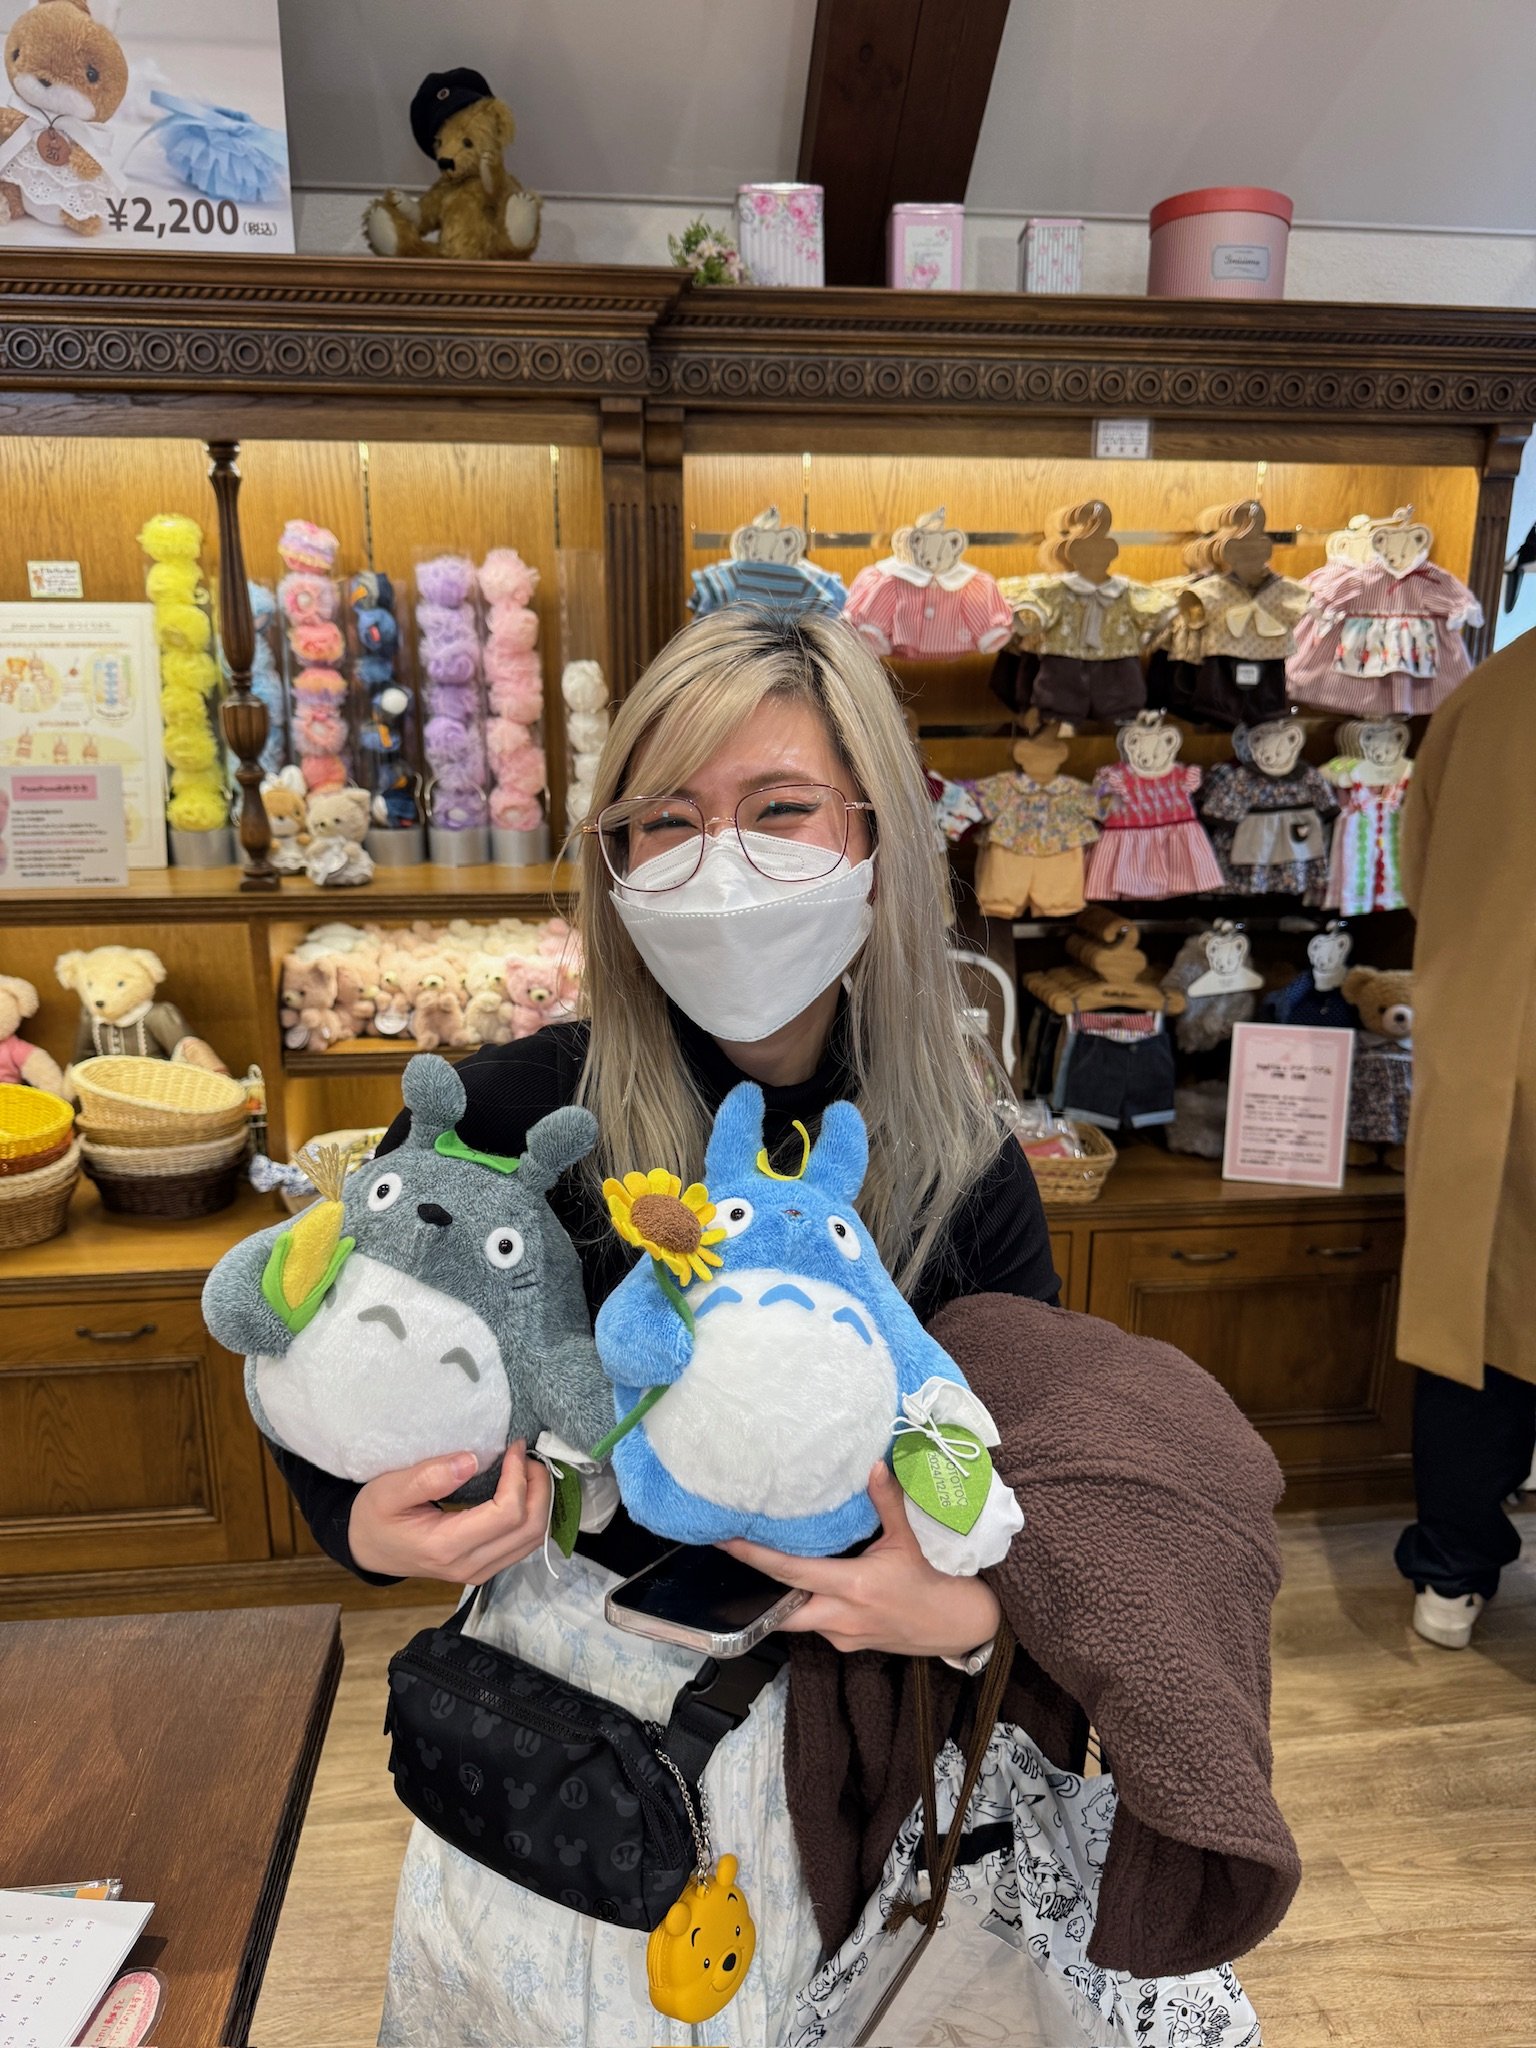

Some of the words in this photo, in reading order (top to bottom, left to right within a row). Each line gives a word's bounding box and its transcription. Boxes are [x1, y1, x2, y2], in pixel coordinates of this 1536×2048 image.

[105, 197, 239, 239] ¥2,200
[243, 222, 278, 236] (税込)
[927, 1452, 951, 1508] 2024/12/26
[4, 1972, 15, 1980] 12
[18, 1953, 28, 1961] 13
[44, 1916, 54, 1925] 15
[11, 1993, 21, 2002] 18
[26, 1974, 35, 1982] 19
[39, 1955, 48, 1965] 20
[52, 1938, 62, 1946] 21
[64, 1919, 74, 1928] 22
[4, 2036, 14, 2046] 23
[18, 2016, 29, 2026] 24
[32, 1996, 42, 2005] 25
[46, 1976, 56, 1986] 26
[59, 1957, 69, 1966] 27
[72, 1939, 81, 1948] 28
[85, 1920, 95, 1930] 29
